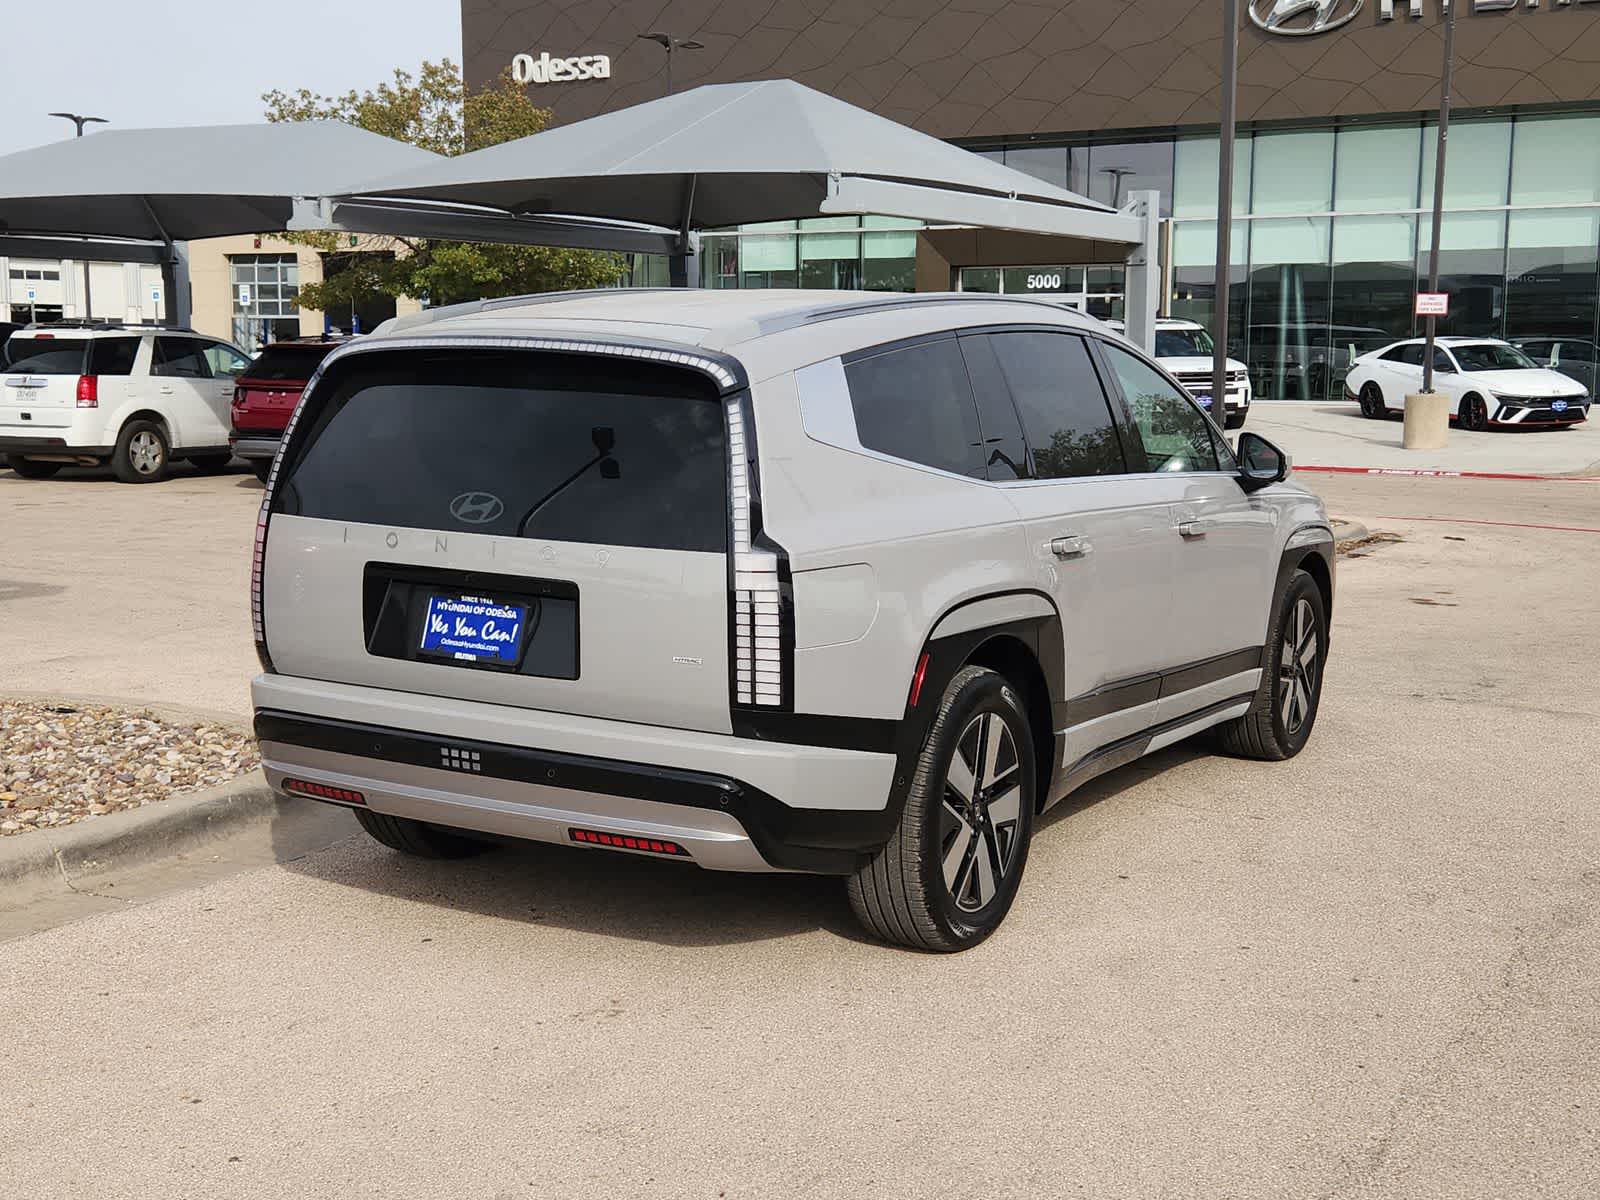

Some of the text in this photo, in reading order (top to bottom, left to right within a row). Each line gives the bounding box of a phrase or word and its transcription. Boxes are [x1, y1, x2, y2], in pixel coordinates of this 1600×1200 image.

[512, 52, 610, 83] Odessa
[1027, 274, 1061, 289] 5000
[437, 601, 517, 619] HYUNDAI OF ODESSA
[430, 613, 519, 643] Yes You Can!
